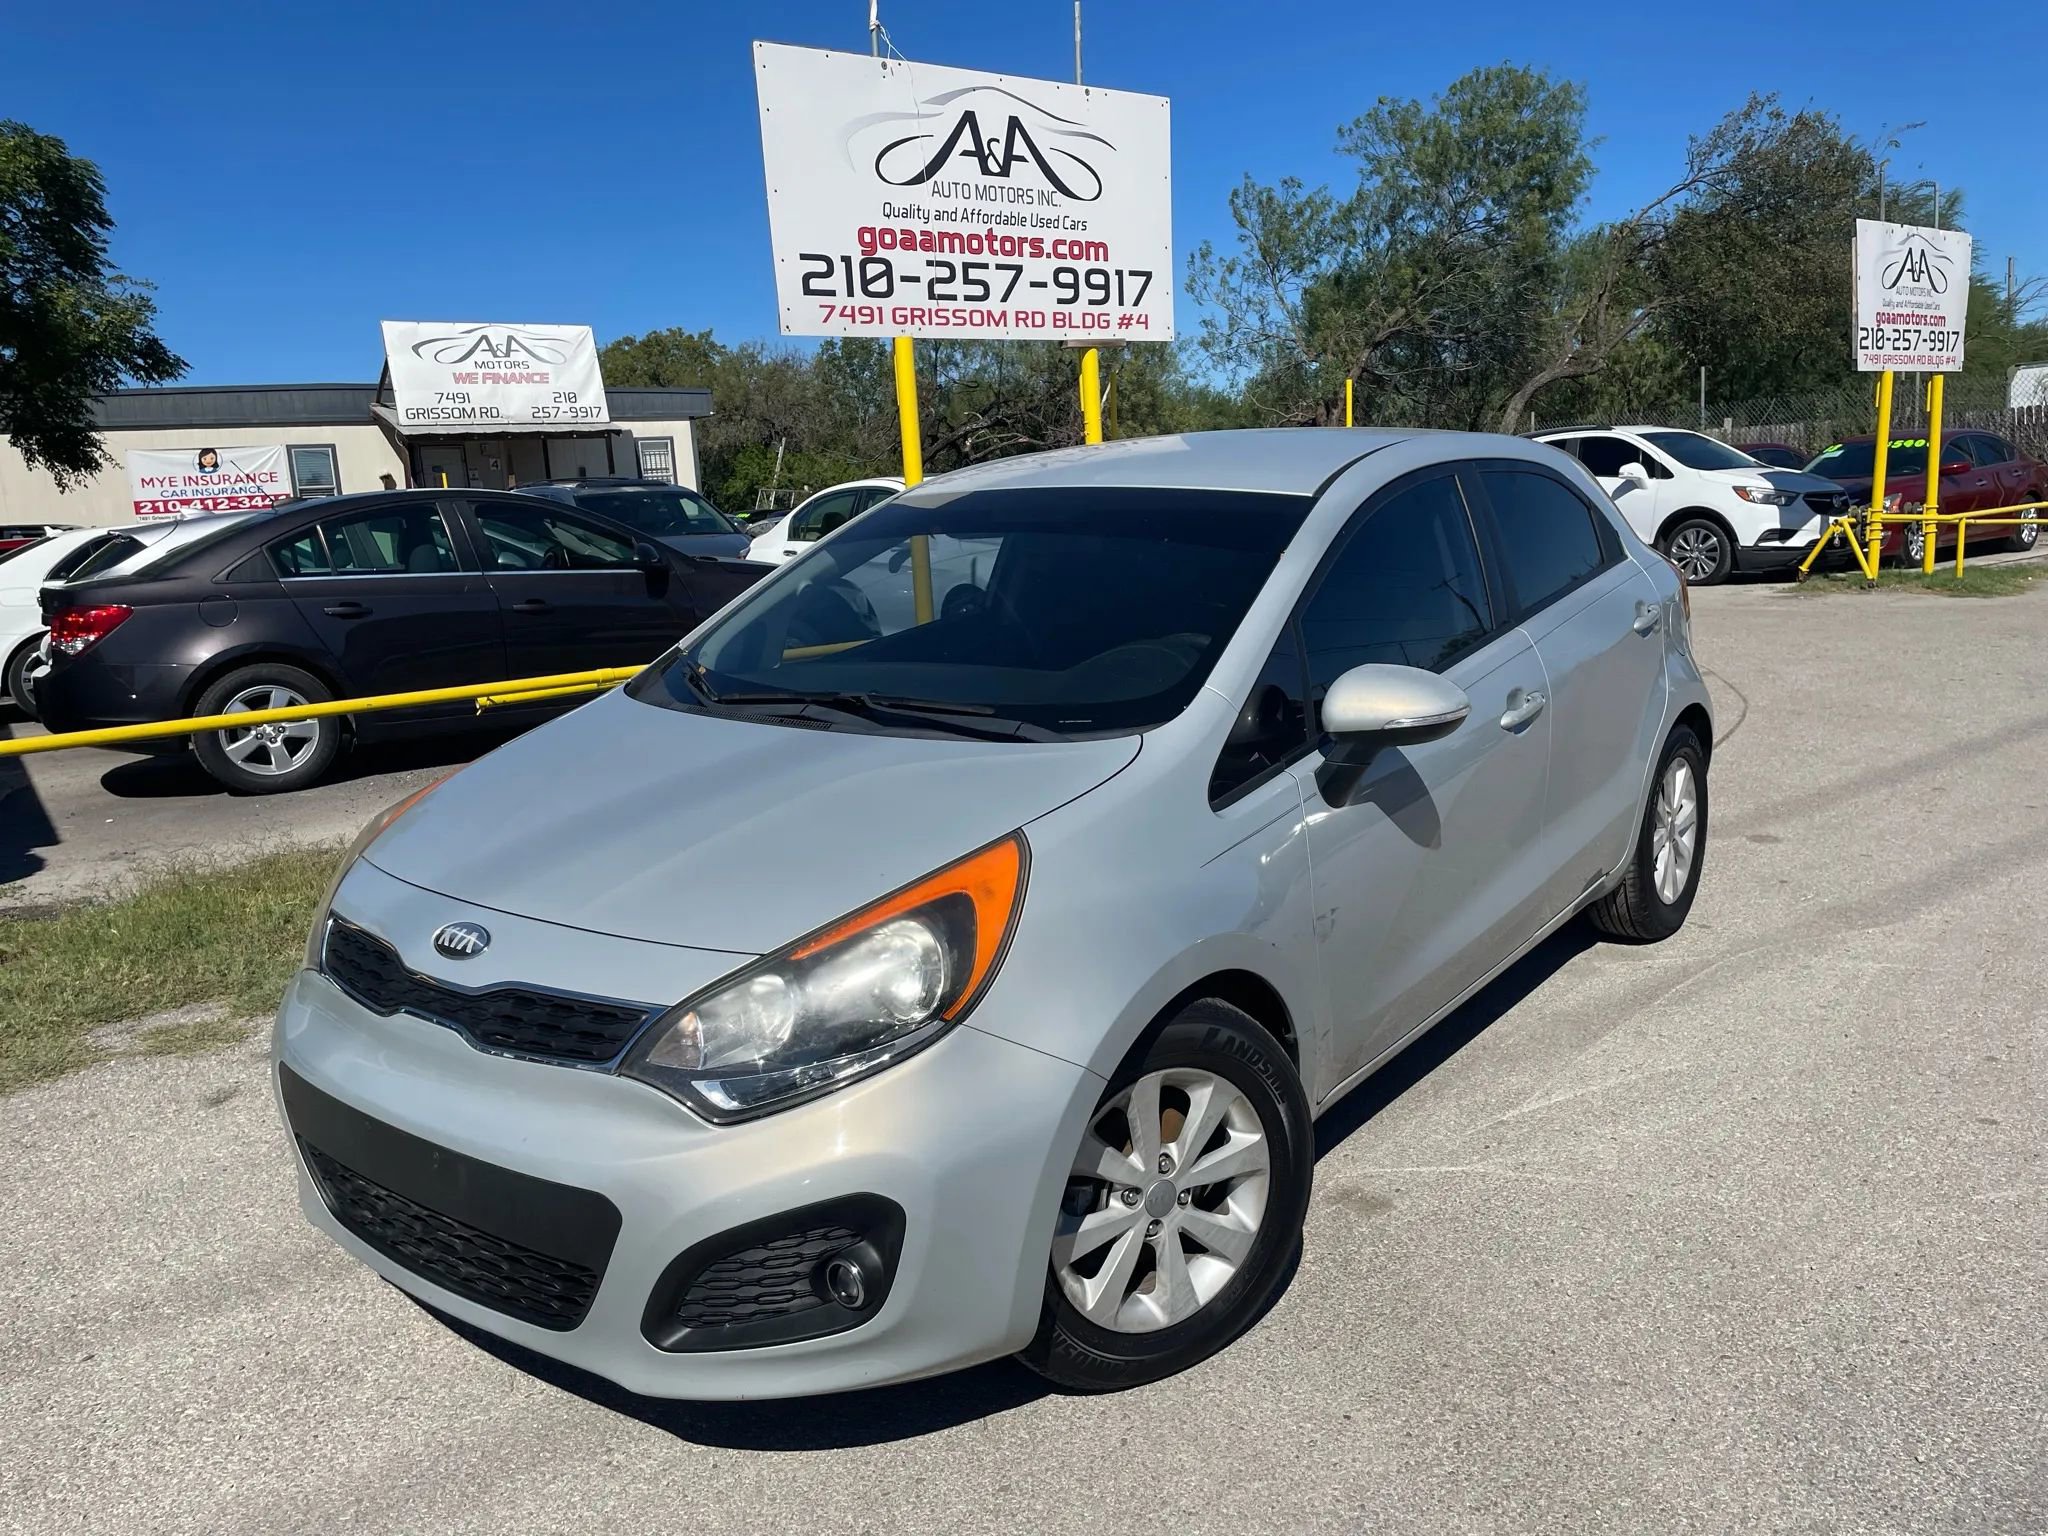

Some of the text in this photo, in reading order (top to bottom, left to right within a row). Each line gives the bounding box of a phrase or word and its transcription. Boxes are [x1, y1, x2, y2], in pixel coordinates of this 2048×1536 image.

[931, 180, 1062, 208] AUTO MOTORS INC.
[882, 202, 1088, 232] Quality and Affordable Used Cars
[857, 226, 1109, 262] goaamotors.com
[799, 253, 1153, 307] 210-257-9917
[818, 304, 1150, 330] 7491 GRISSOM RD BLDG #4
[1875, 310, 1946, 327] goaamotors.com
[1859, 327, 1960, 352] 210-257-9917
[474, 360, 530, 370] MOTORS
[1863, 354, 1956, 366] 7491 GRISSOM RD BLDG #4
[453, 372, 550, 385] WE FINANCE
[434, 392, 471, 404] 7491
[552, 392, 577, 403] 210
[405, 407, 504, 420] GRISSOM RD.
[531, 406, 601, 419] 257-9917
[140, 472, 279, 488] MYE INSURANCE
[160, 485, 265, 498] CAR INSURANCE
[437, 926, 484, 953] KIA
